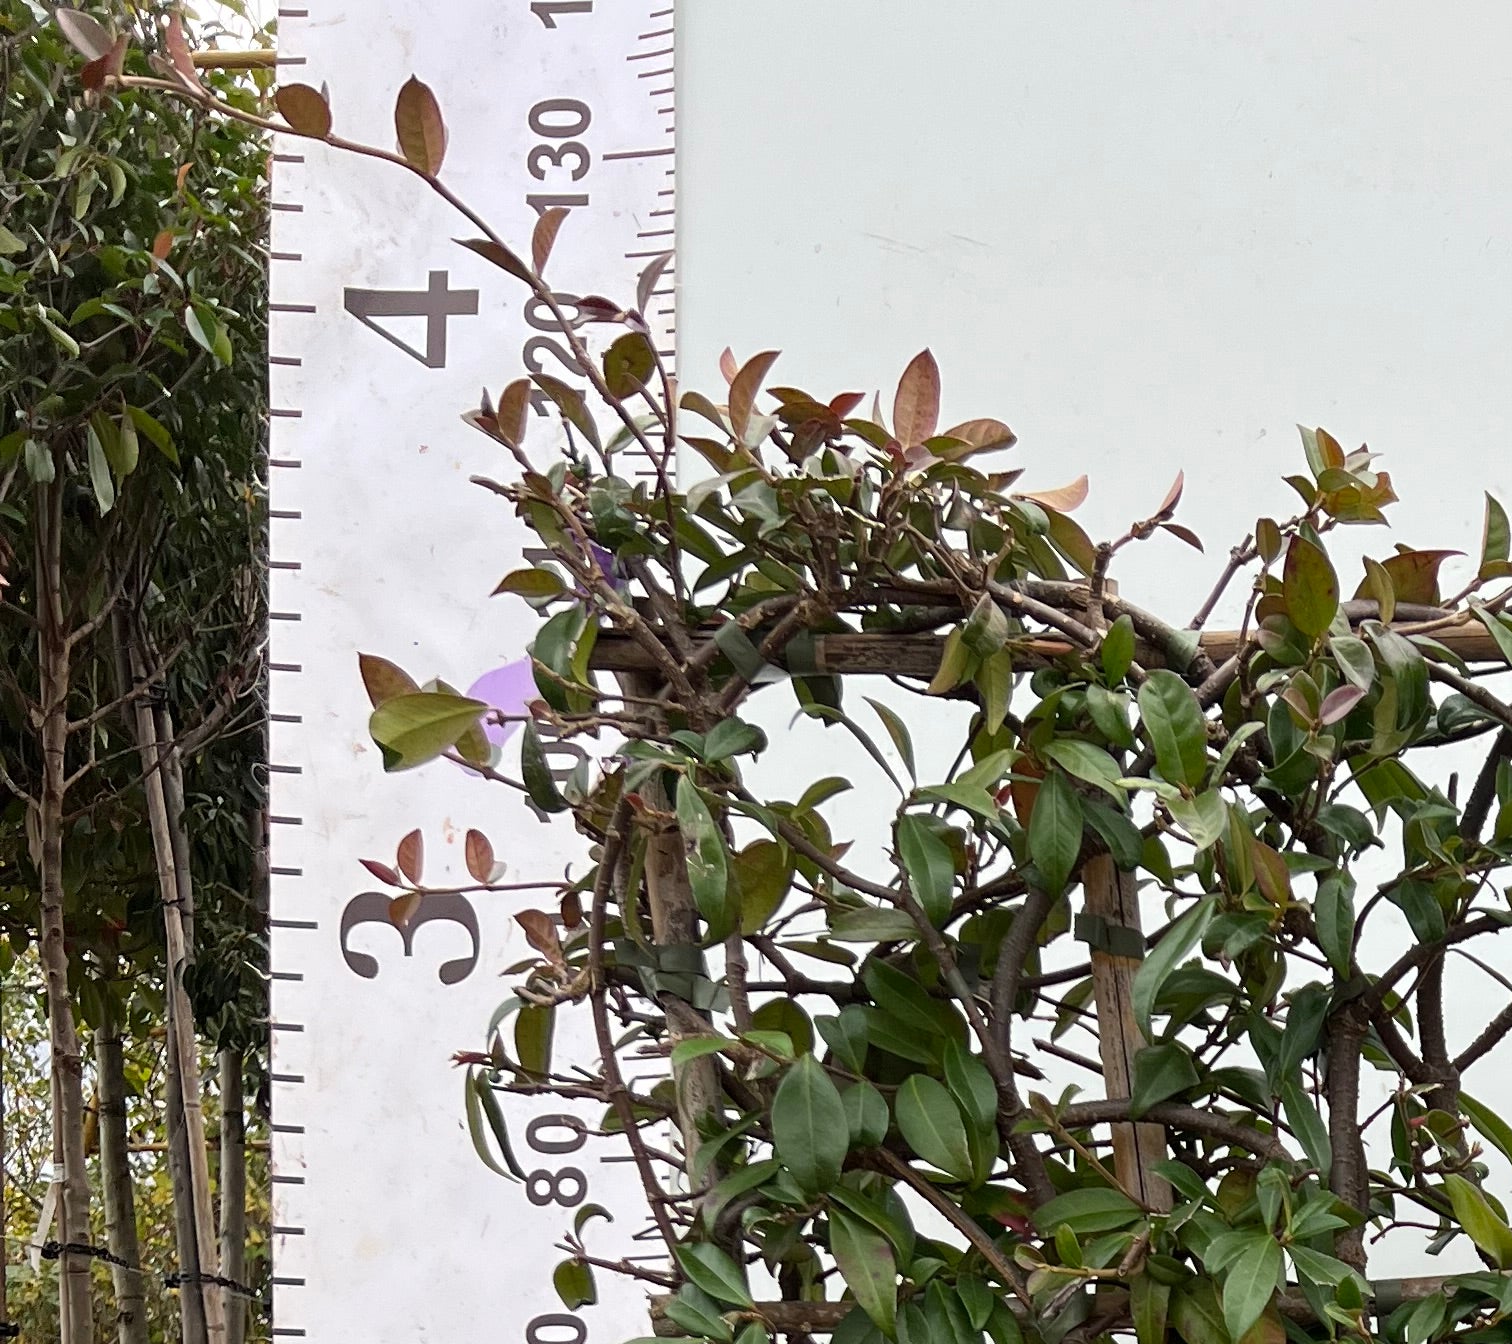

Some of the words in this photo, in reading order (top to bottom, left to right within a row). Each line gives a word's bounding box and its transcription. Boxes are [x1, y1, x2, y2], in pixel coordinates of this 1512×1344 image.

[526, 98, 592, 216] 130
[344, 270, 479, 369] 4
[340, 892, 480, 985] 3
[526, 1114, 587, 1207] 80
